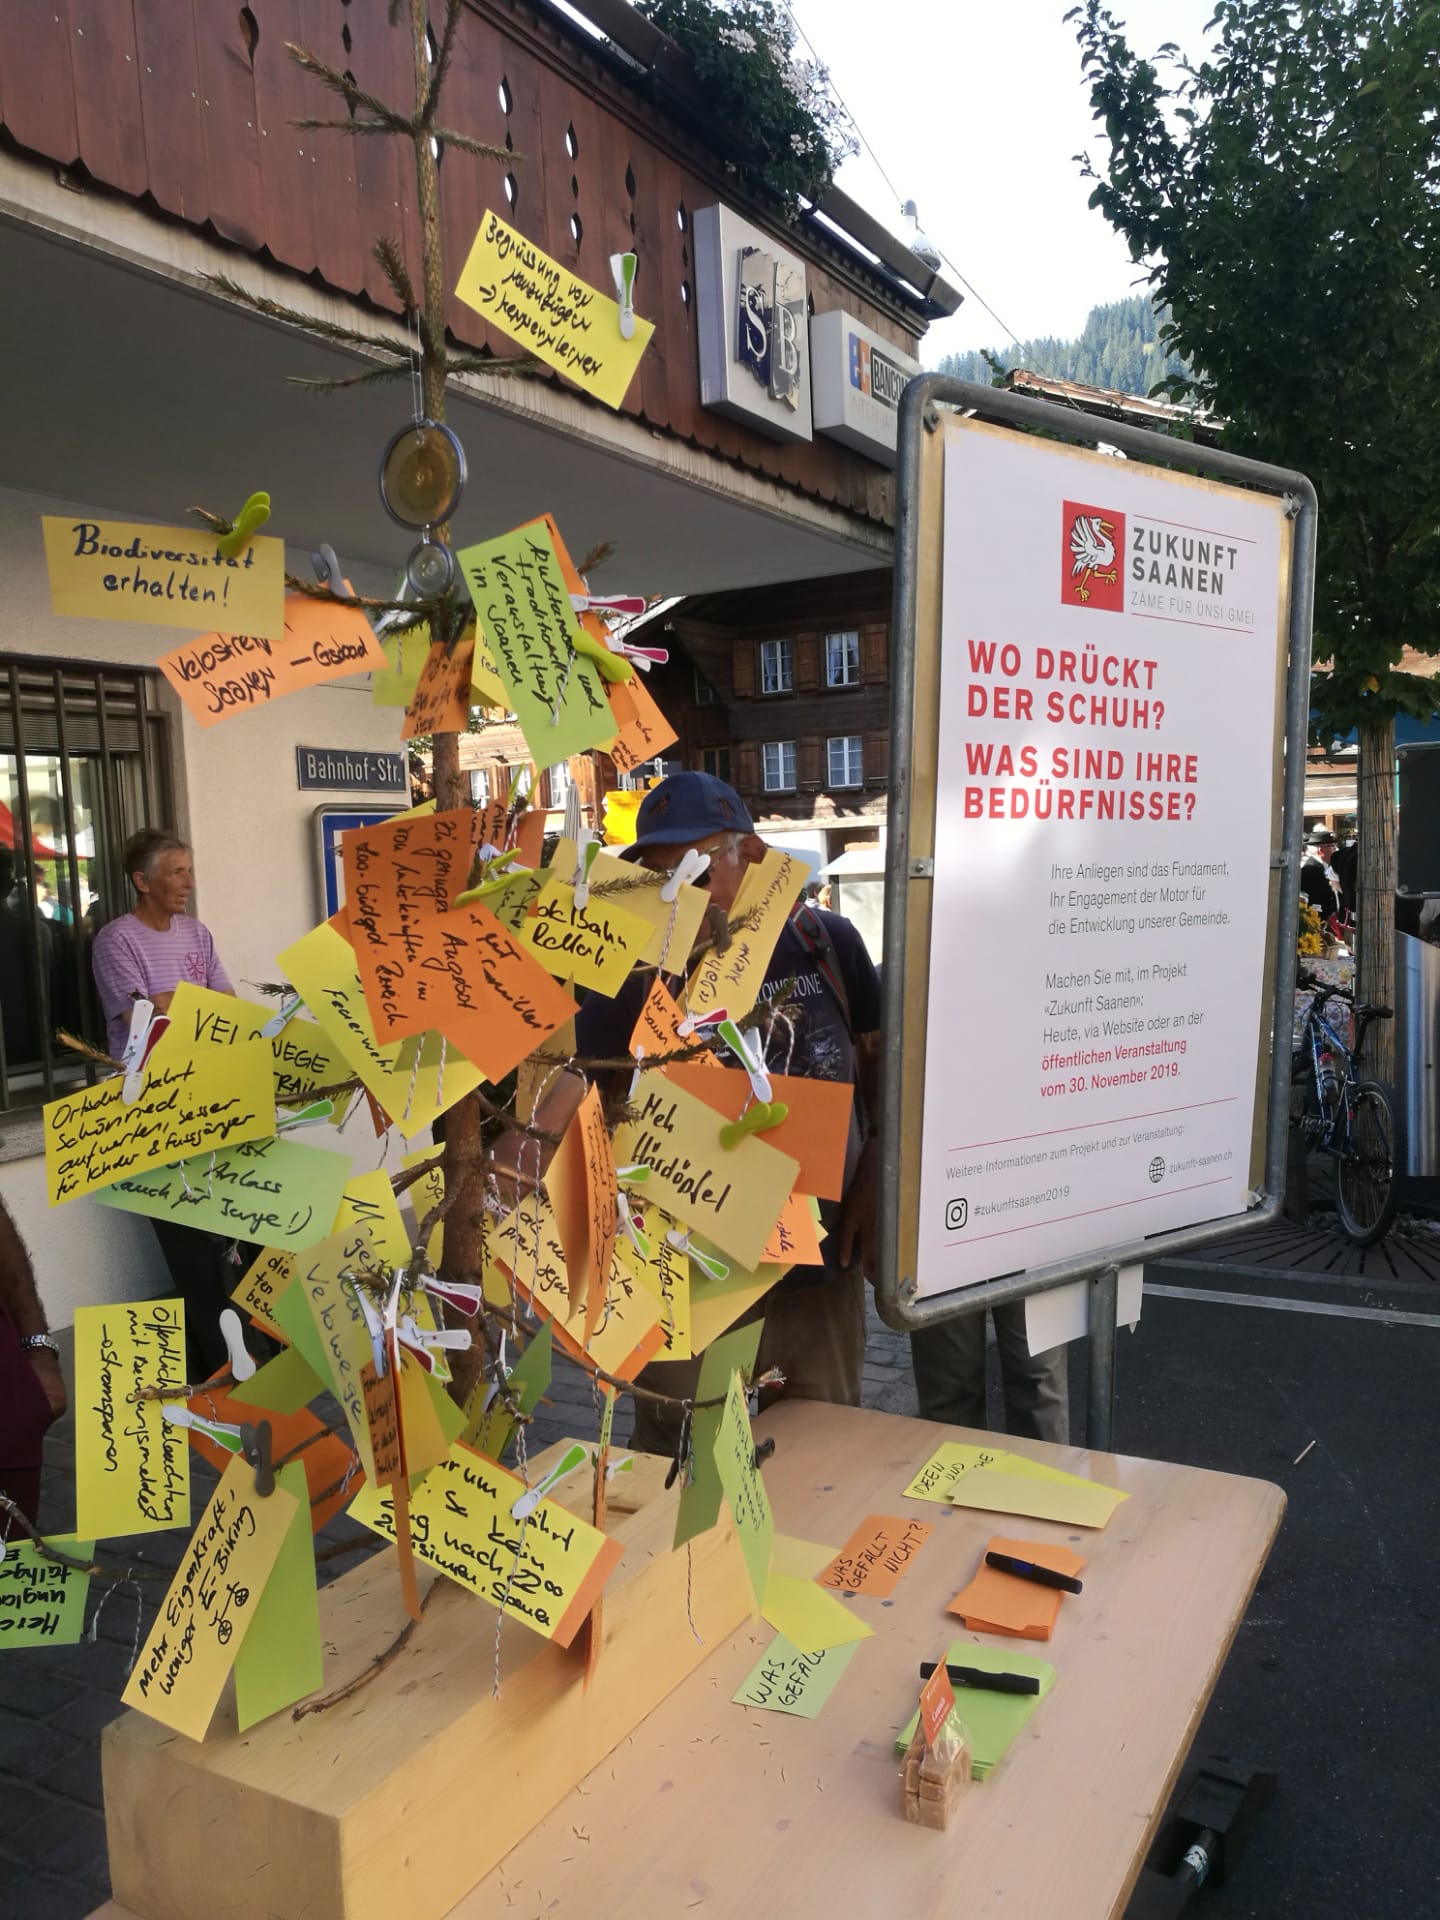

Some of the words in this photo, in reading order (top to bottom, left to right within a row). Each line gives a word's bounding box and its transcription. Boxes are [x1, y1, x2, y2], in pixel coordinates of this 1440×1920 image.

[568, 282, 594, 309] von
[1133, 527, 1237, 571] ZUKUNFT
[103, 566, 230, 608] erhalten!
[471, 567, 487, 588] in
[1131, 556, 1225, 596] SAANEN
[1169, 594, 1192, 616] FÜR
[968, 639, 1021, 678] WO
[1036, 643, 1158, 690] DRÜCKT
[968, 684, 1033, 721] DER
[1046, 691, 1165, 730] SCHUH?
[307, 754, 401, 782] Bahnhof-Str.
[965, 743, 1038, 778] WAS
[1051, 747, 1124, 780] SIND
[1136, 752, 1198, 784] IHRE
[964, 779, 1197, 821] BEDÜRFNISSE?
[1051, 863, 1073, 881] Ihre
[1076, 863, 1124, 882] Anliegen
[1126, 861, 1148, 878] sind
[1151, 861, 1169, 878] das
[1171, 860, 1230, 879] Fundament,
[1049, 891, 1066, 908] Ihr
[1068, 889, 1137, 910] Engagement
[1139, 888, 1157, 904] der
[1159, 887, 1189, 903] Motor
[1191, 886, 1206, 902] für
[1048, 918, 1067, 935] die
[1069, 915, 1135, 935] Entwicklung
[1138, 915, 1176, 930] unserer
[1178, 911, 1230, 928] Gemeinde.
[1045, 972, 1091, 989] Machen
[1093, 969, 1112, 986] Sie
[1115, 968, 1134, 985] mit,
[1136, 966, 1149, 981] im
[1152, 963, 1187, 982] Projekt
[1044, 997, 1093, 1017] «Zukunft
[321, 988, 394, 1076] Feuerwehr
[1043, 1025, 1081, 1044] Heute,
[1084, 1023, 1100, 1039] via
[1102, 1018, 1145, 1037] Website
[1147, 1015, 1170, 1032] oder
[1172, 1016, 1185, 1029] an
[1188, 1010, 1205, 1026] der
[1041, 1047, 1111, 1071] öffentlichen
[1114, 1038, 1187, 1061] Veranstaltung
[1040, 1081, 1066, 1097] vom
[1069, 1077, 1088, 1095] 30.
[1091, 1069, 1147, 1090] November
[1150, 1063, 1181, 1081] 2019.
[945, 1161, 982, 1180] Weitere
[985, 1151, 1048, 1174] Informationen
[1049, 1148, 1067, 1163] zum
[1069, 1139, 1100, 1160] Projekt
[1101, 1136, 1117, 1152] und
[1119, 1134, 1131, 1149] zur
[1132, 1124, 1185, 1145] Veranstaltung:
[1169, 1149, 1233, 1174] zukunft-saanen.ch
[56, 1174, 80, 1201] für
[973, 1185, 1070, 1218] #zukunftsaanen2019
[846, 1531, 889, 1590] GEFÄLLT
[882, 1522, 930, 1575] NICHT?
[827, 1558, 853, 1588] WAS
[139, 1638, 169, 1699] Mehr
[746, 1658, 785, 1705] WAS
